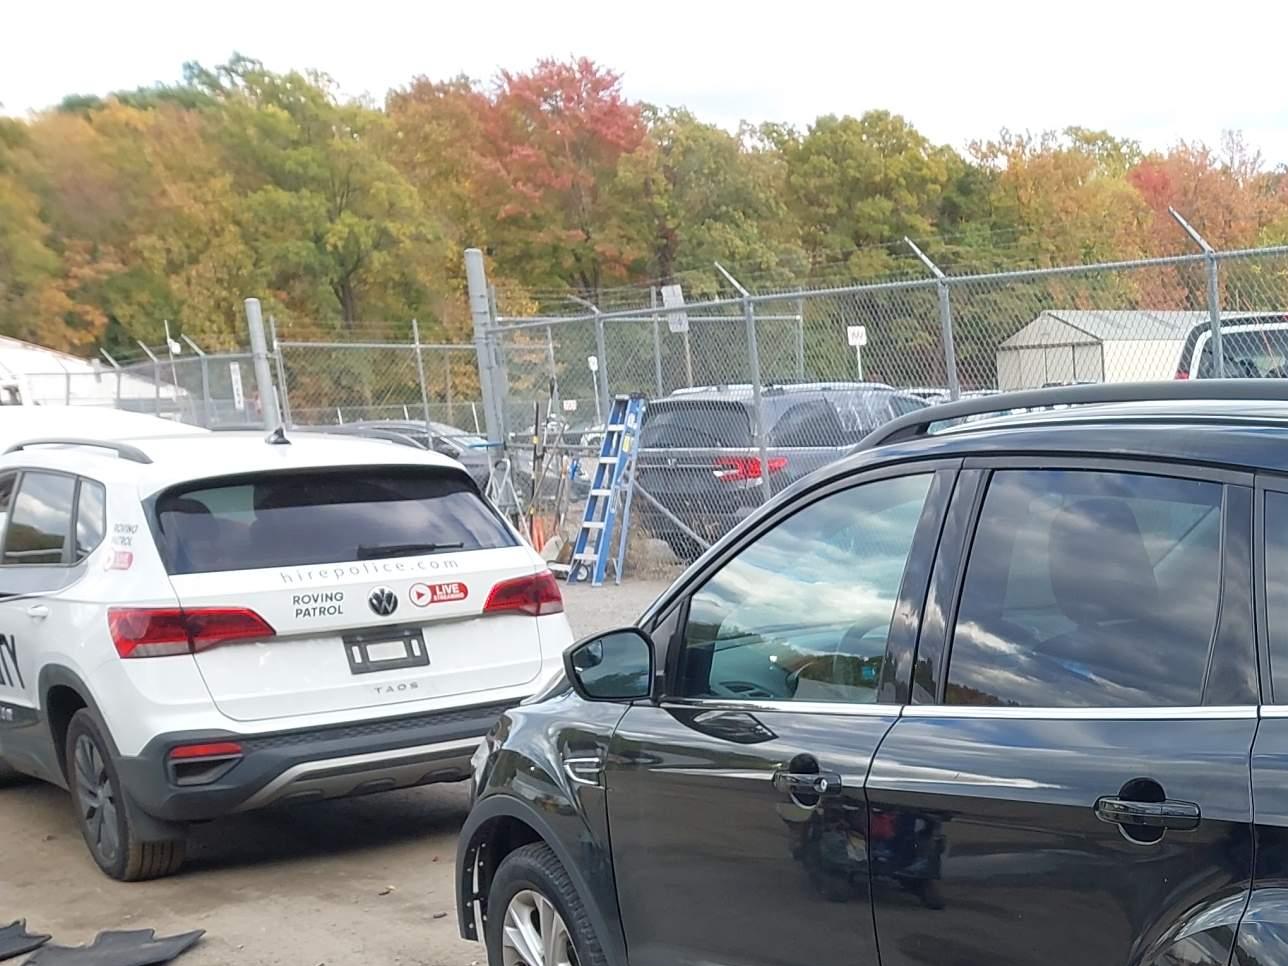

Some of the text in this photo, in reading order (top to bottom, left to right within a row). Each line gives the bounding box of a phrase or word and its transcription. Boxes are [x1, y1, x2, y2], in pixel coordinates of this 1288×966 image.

[280, 559, 459, 584] hirepolice.com
[435, 583, 460, 594] LIVE
[292, 591, 344, 605] ROVING
[295, 606, 344, 618] PATROL
[374, 682, 418, 694] TAOS
